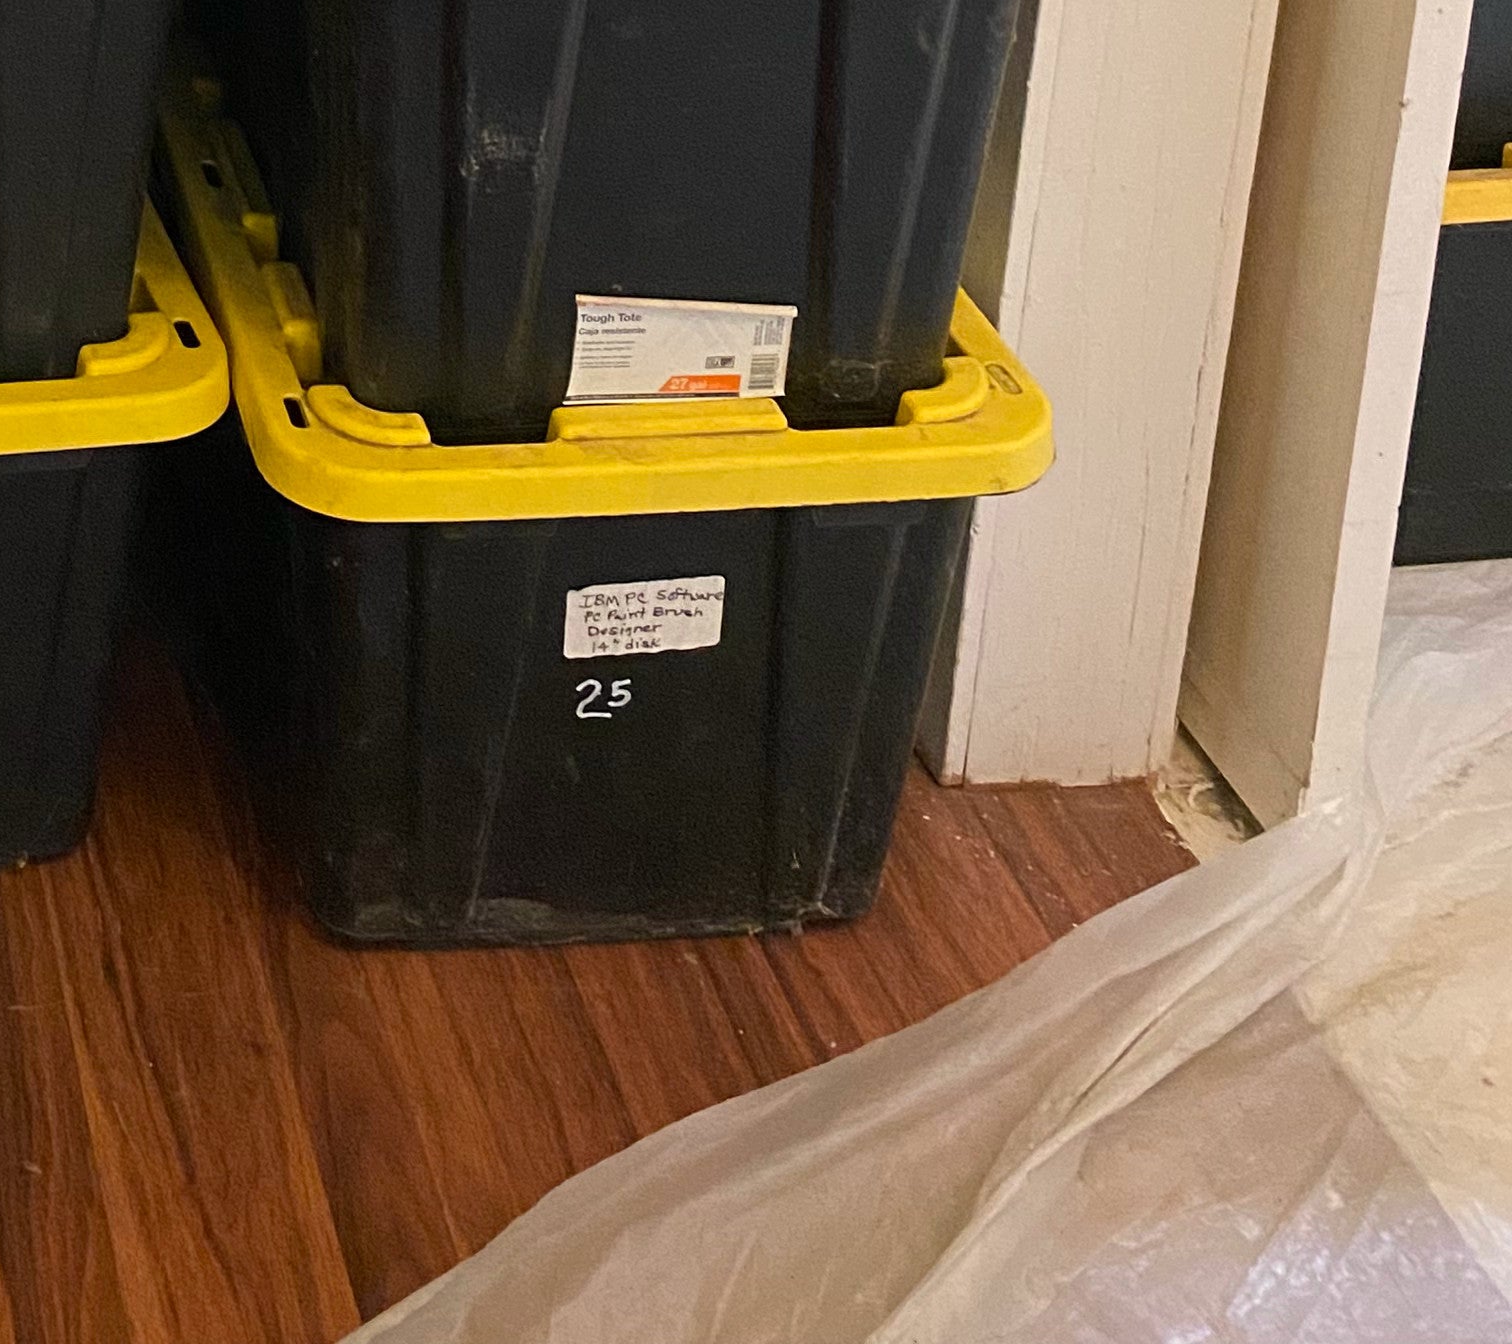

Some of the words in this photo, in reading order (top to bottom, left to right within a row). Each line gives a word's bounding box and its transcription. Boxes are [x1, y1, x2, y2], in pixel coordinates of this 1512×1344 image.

[581, 314, 615, 324] Tough
[618, 313, 642, 322] Tote
[669, 378, 688, 390] 27
[579, 593, 619, 609] IBM
[625, 592, 648, 605] PC
[656, 587, 724, 603] Software
[584, 611, 601, 623] PC
[607, 608, 646, 622] Paint
[588, 623, 662, 637] Designer
[576, 678, 632, 719] 25
